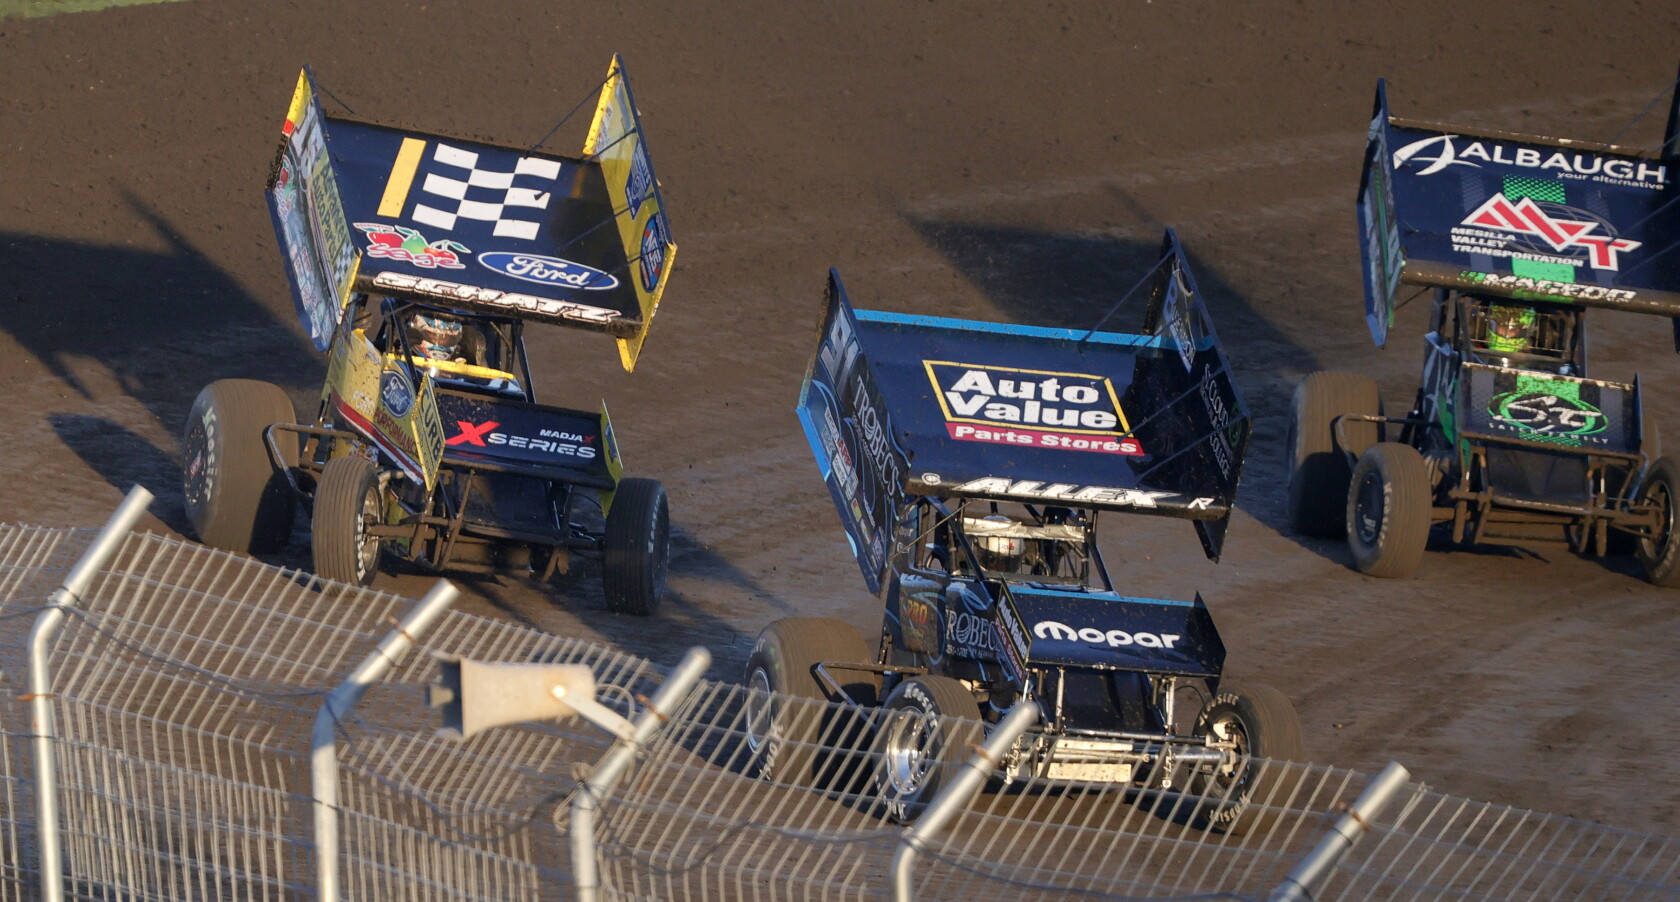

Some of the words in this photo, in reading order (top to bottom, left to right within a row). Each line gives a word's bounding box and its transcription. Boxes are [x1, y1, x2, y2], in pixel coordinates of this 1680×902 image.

[1459, 141, 1668, 184] ALBAUGH
[1556, 171, 1589, 182] your
[1592, 175, 1665, 191] alternative
[1451, 226, 1517, 242] MESILLA
[1451, 235, 1509, 248] VALLEY
[505, 254, 592, 289] Ford
[1452, 244, 1585, 267] TRANSPORTATION
[372, 271, 623, 325] SCHATZ
[950, 368, 1101, 405] Auto
[420, 388, 442, 459] CURB
[944, 390, 1118, 429] Value
[446, 420, 500, 447] X
[487, 432, 596, 459] SERIES
[853, 375, 900, 496] TROBECS
[955, 424, 1035, 447] Parts
[1040, 433, 1139, 454] Stores
